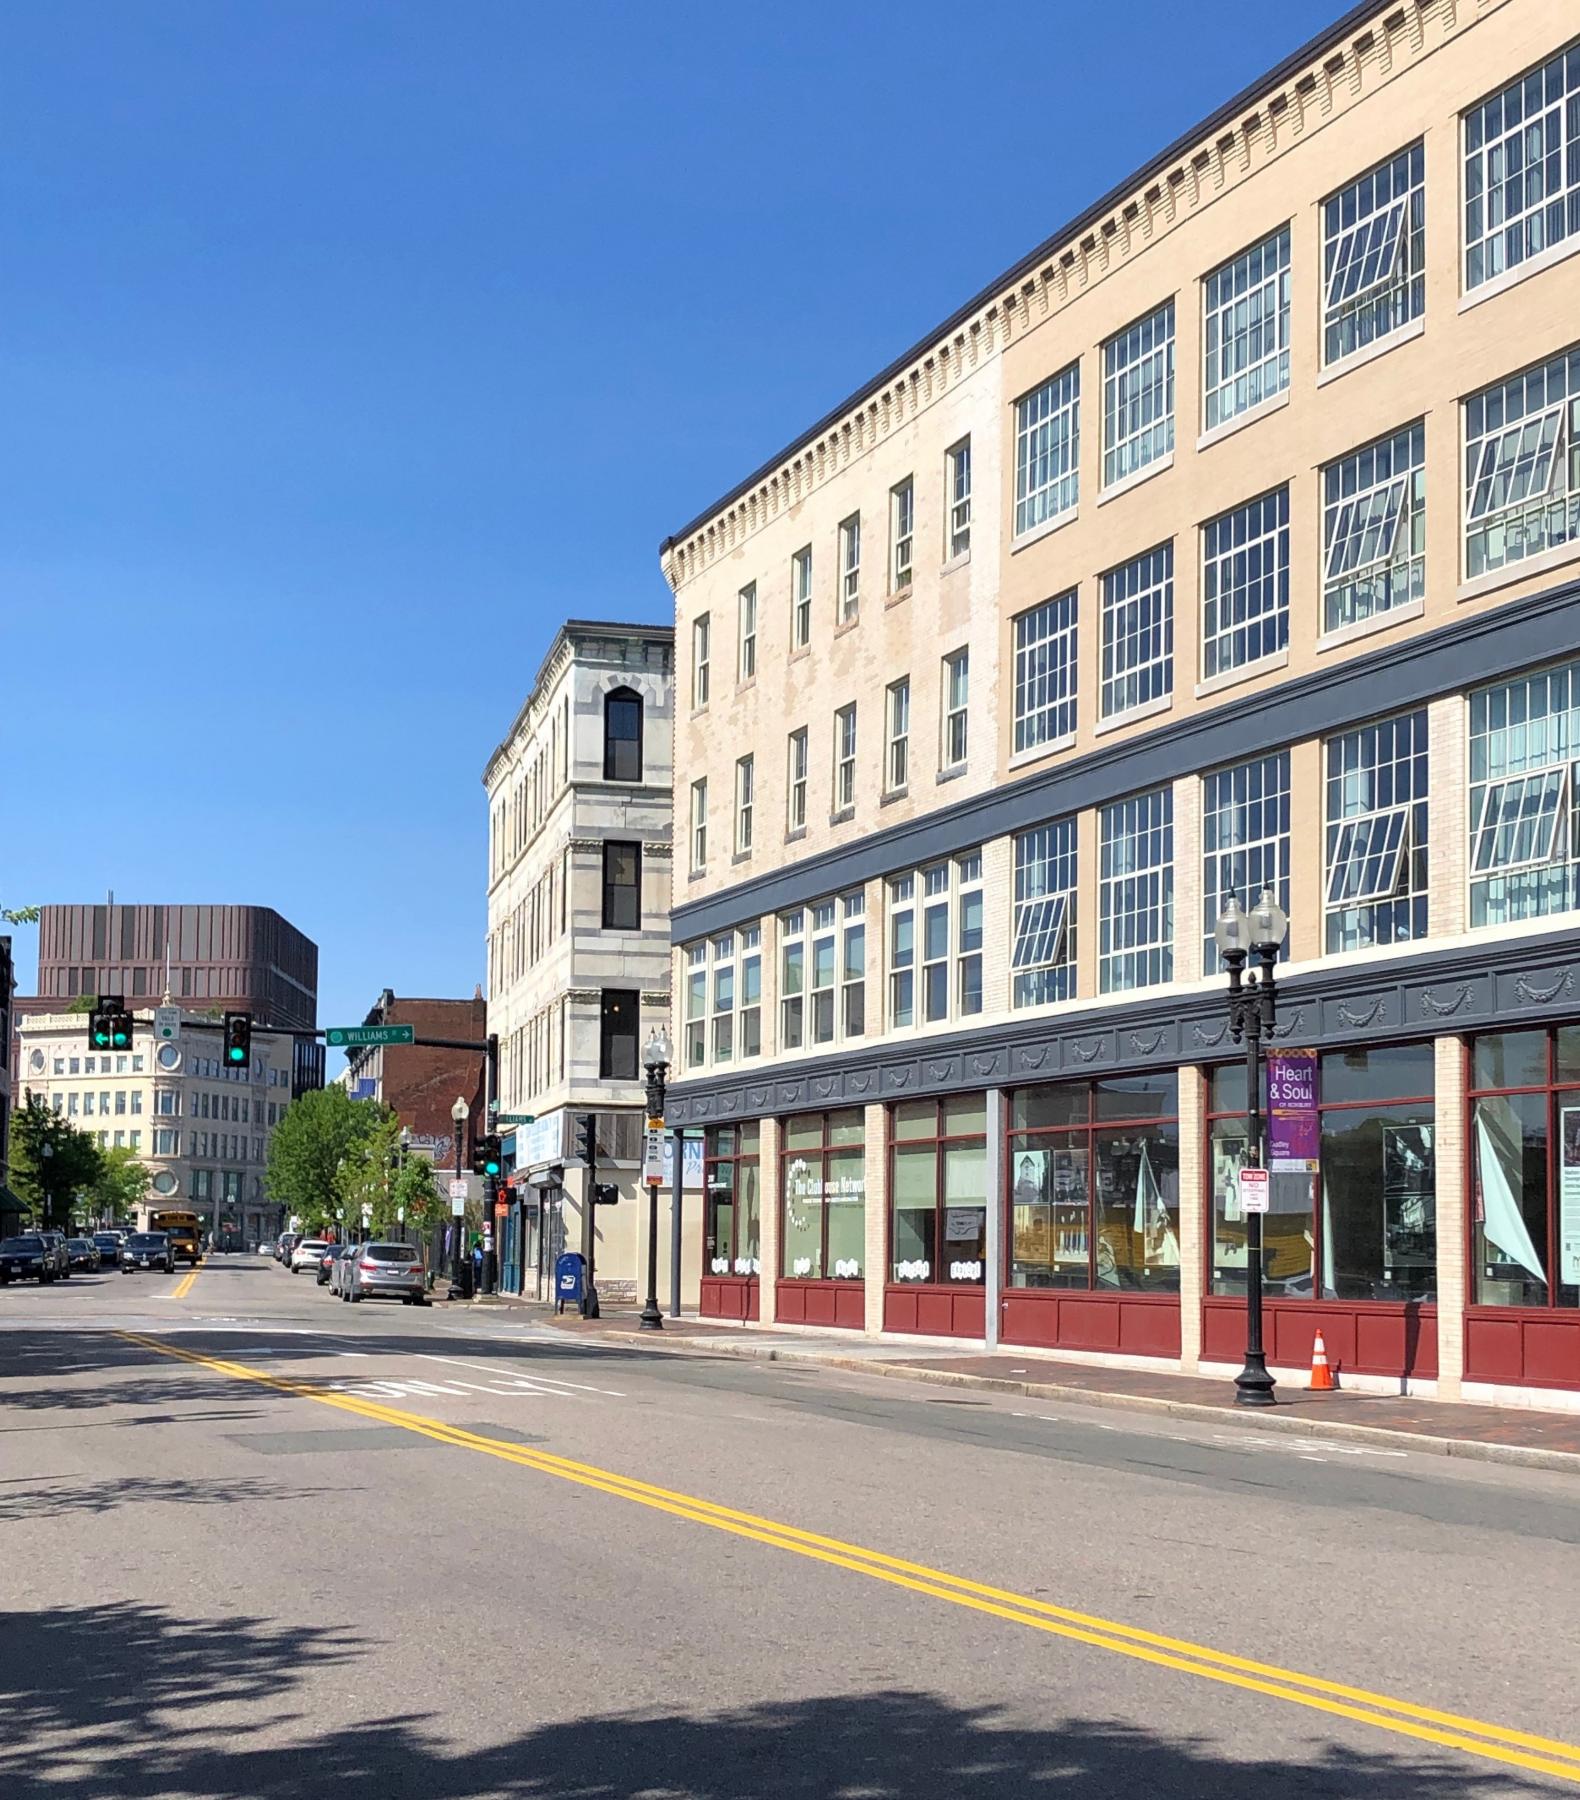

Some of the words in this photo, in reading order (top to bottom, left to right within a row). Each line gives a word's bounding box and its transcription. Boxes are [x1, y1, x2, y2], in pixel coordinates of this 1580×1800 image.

[347, 1030, 389, 1041] WILLIAMS
[1275, 1065, 1313, 1081] Heart
[1270, 1083, 1280, 1100] &
[1282, 1083, 1313, 1100] Soul
[795, 1178, 806, 1195] The
[807, 1178, 840, 1195] Clubouse
[840, 1176, 865, 1194] Networ
